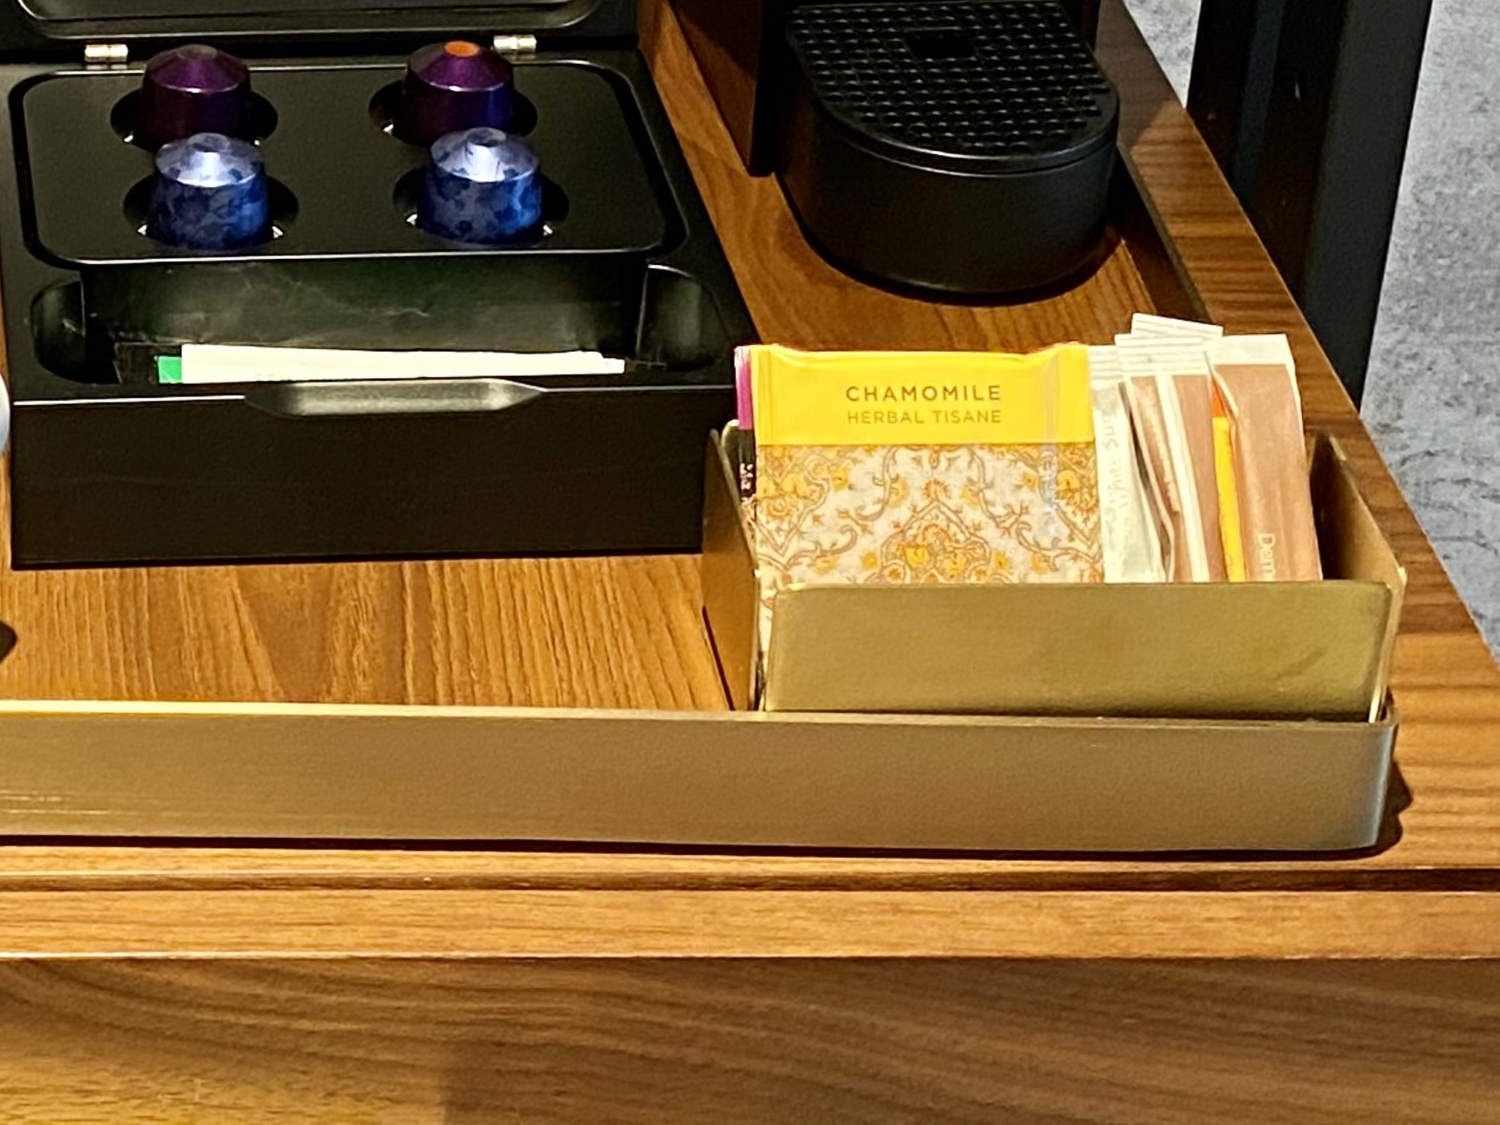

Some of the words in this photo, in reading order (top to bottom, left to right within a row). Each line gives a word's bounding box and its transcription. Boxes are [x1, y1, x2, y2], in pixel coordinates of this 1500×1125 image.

[845, 385, 1001, 402] CHAMOMILE
[847, 410, 924, 424] HERBAL
[931, 409, 1002, 423] TISANE
